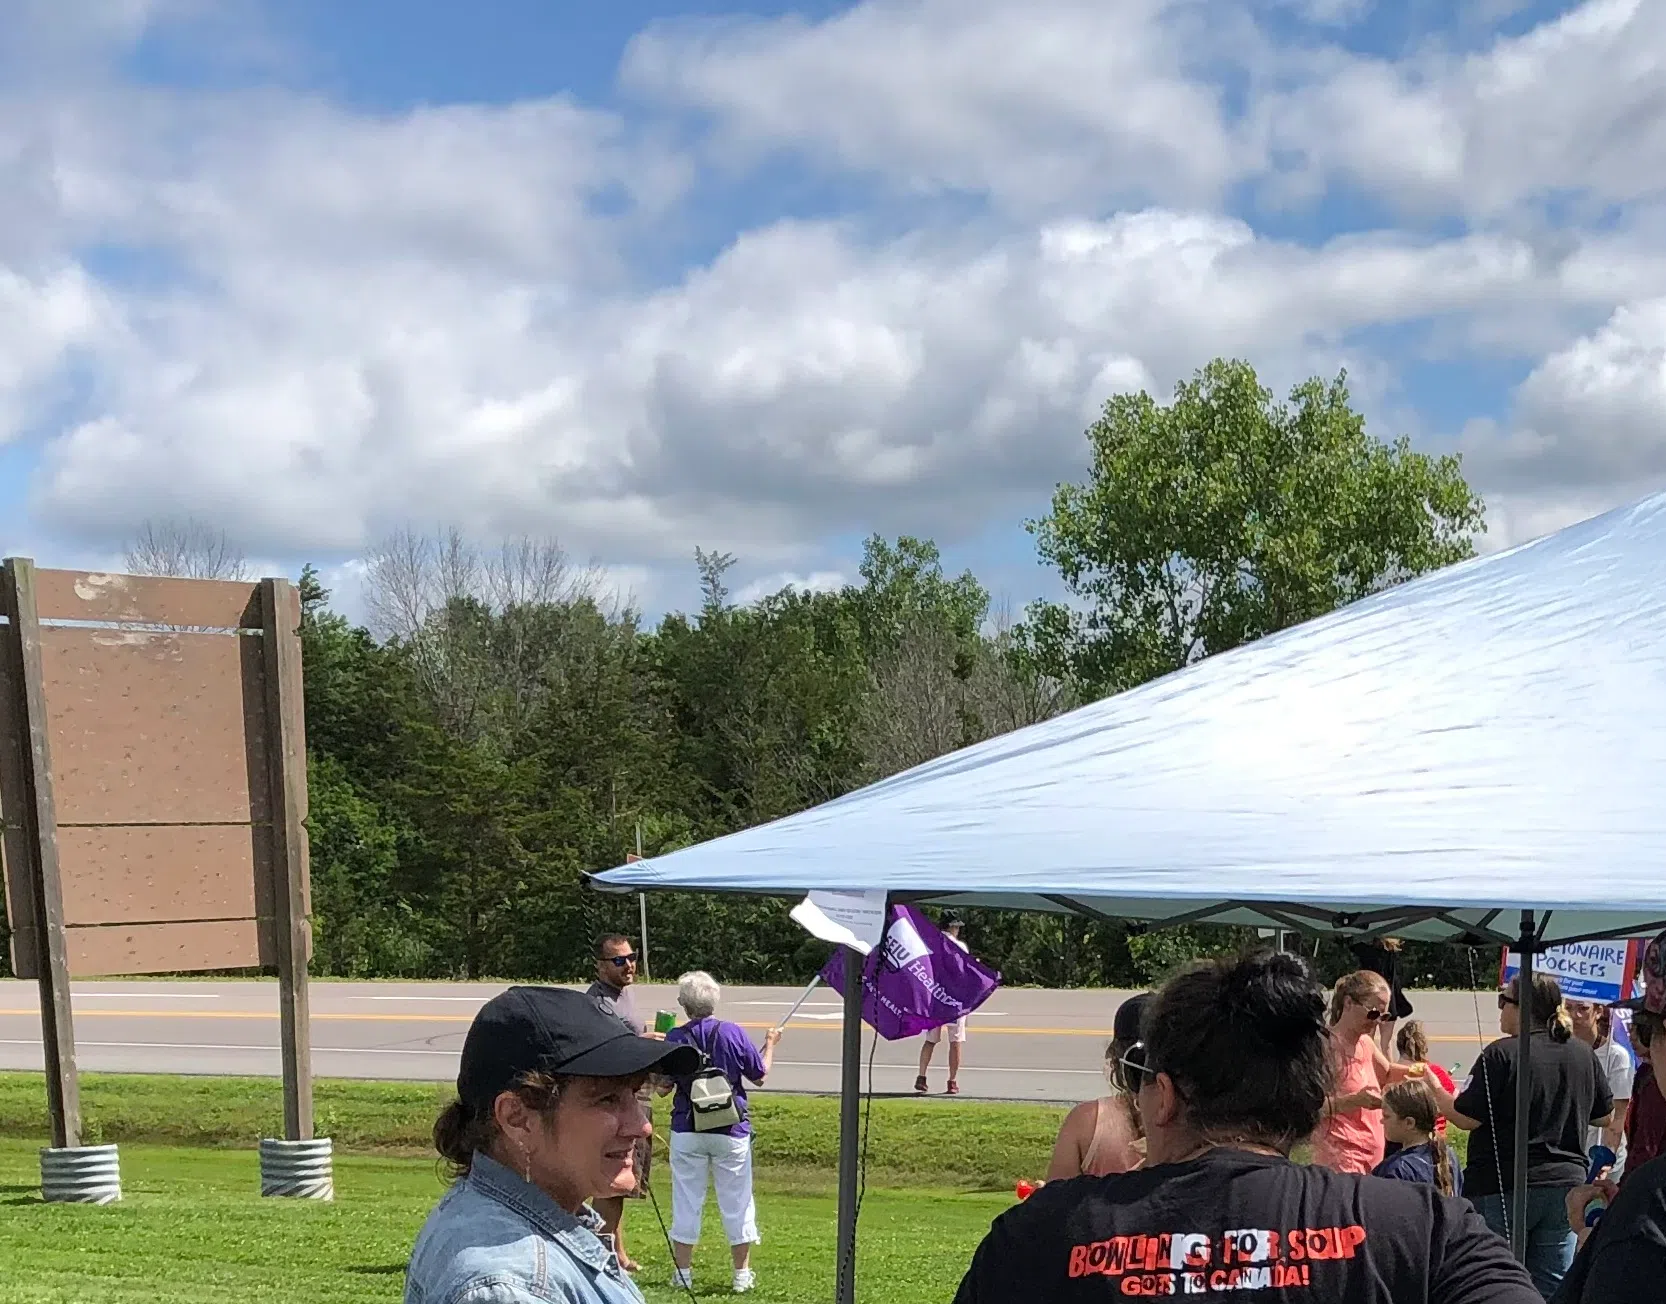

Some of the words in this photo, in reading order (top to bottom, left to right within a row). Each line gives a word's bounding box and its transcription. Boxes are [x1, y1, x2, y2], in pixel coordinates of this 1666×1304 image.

[1535, 952, 1606, 978] POCKETS
[1068, 1233, 1211, 1277] BOWLING
[1223, 1228, 1281, 1264] FOR
[1288, 1225, 1366, 1261] SOUP
[1120, 1273, 1176, 1296] GOES
[1181, 1272, 1207, 1294] TO
[1210, 1264, 1310, 1292] CANADA!
